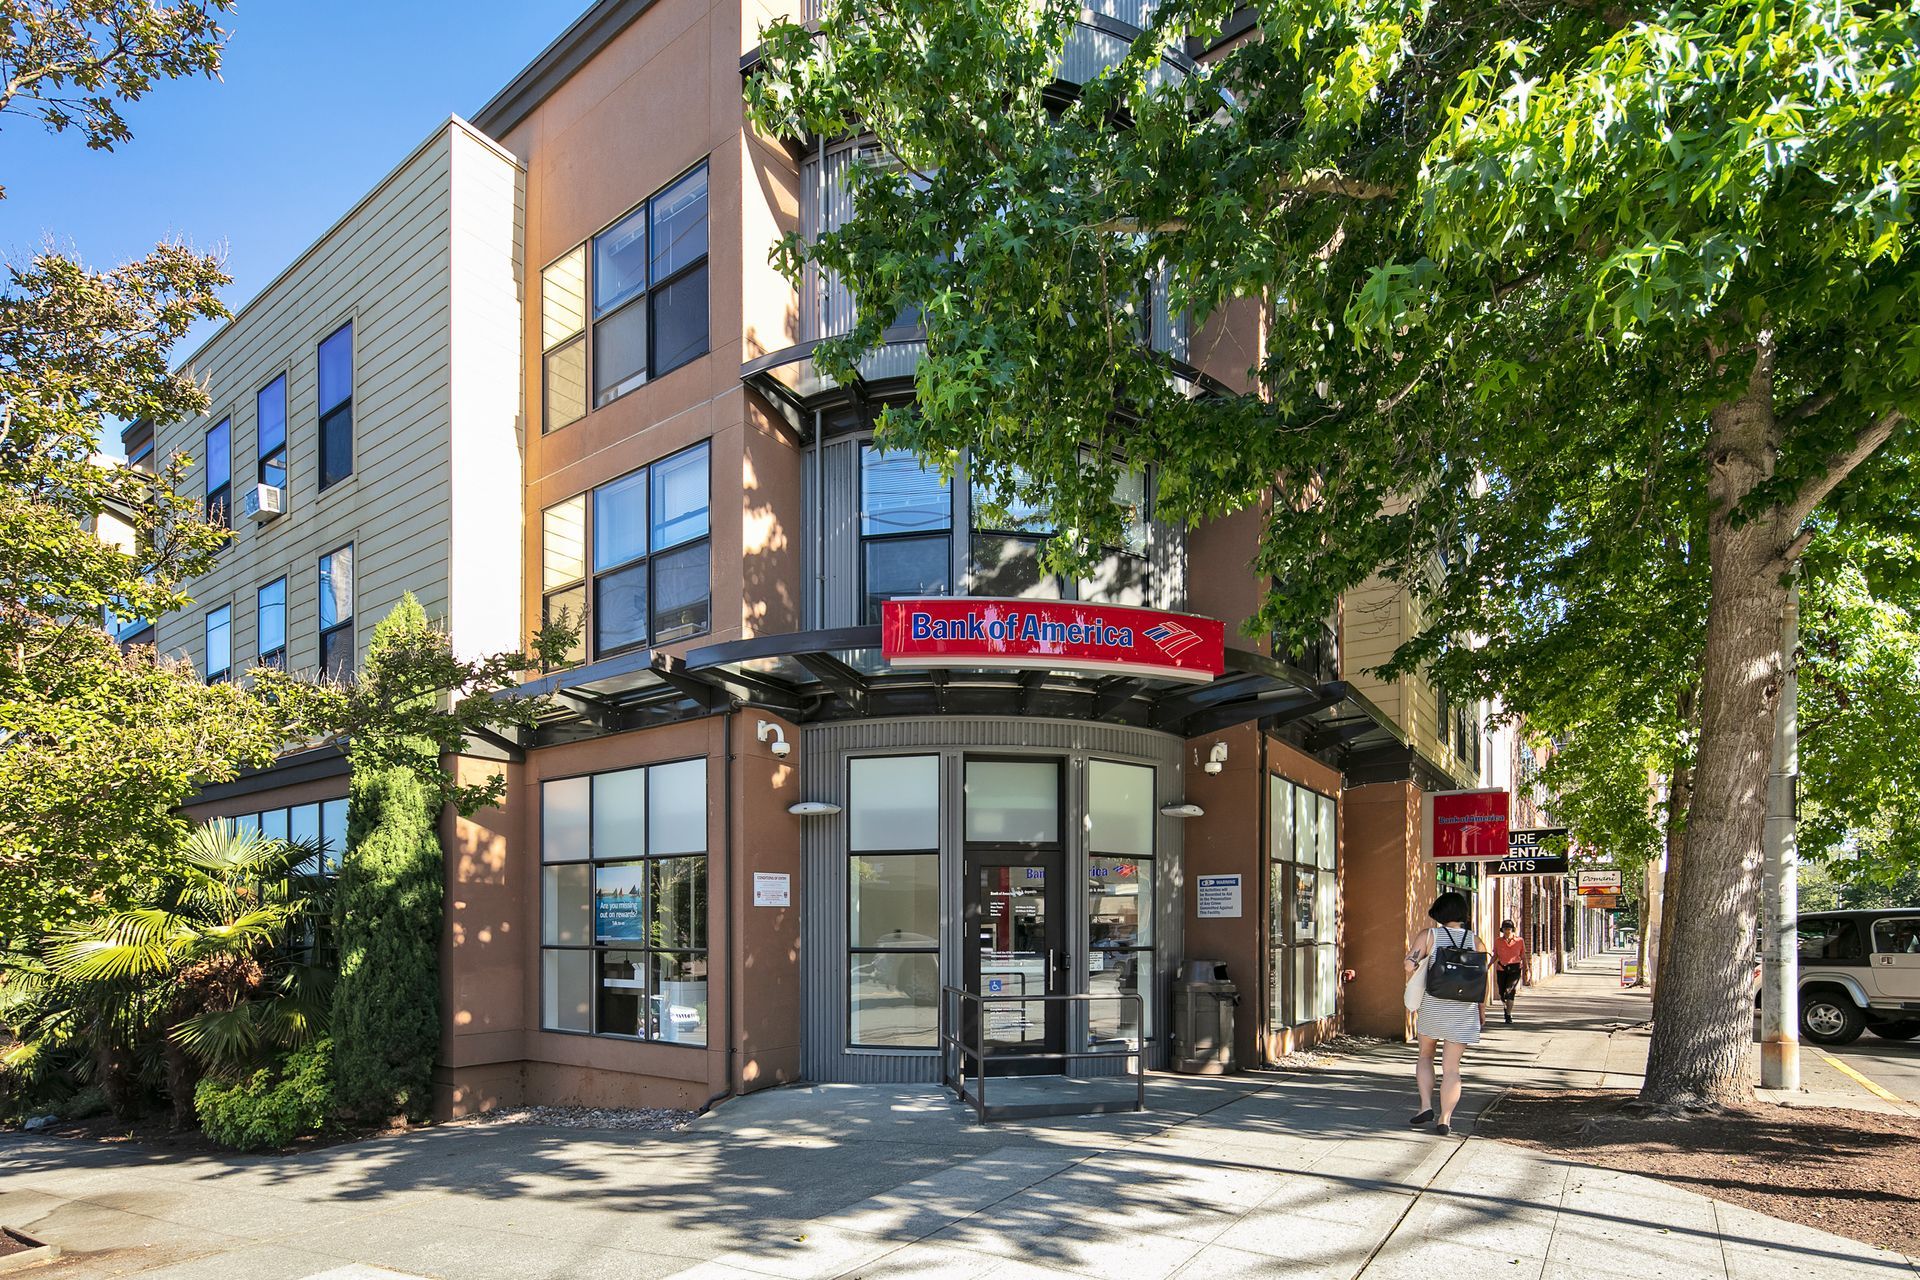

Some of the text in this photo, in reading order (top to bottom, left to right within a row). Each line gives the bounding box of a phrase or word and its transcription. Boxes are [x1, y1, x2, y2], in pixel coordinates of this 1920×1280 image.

[912, 612, 1134, 647] Bank of America
[1438, 815, 1459, 824] Bank
[1470, 813, 1505, 822] America
[1508, 833, 1536, 845] URE
[1503, 846, 1557, 858] ENTAL
[1499, 860, 1536, 872] ARTS
[609, 903, 618, 911] you
[619, 901, 638, 909] missing
